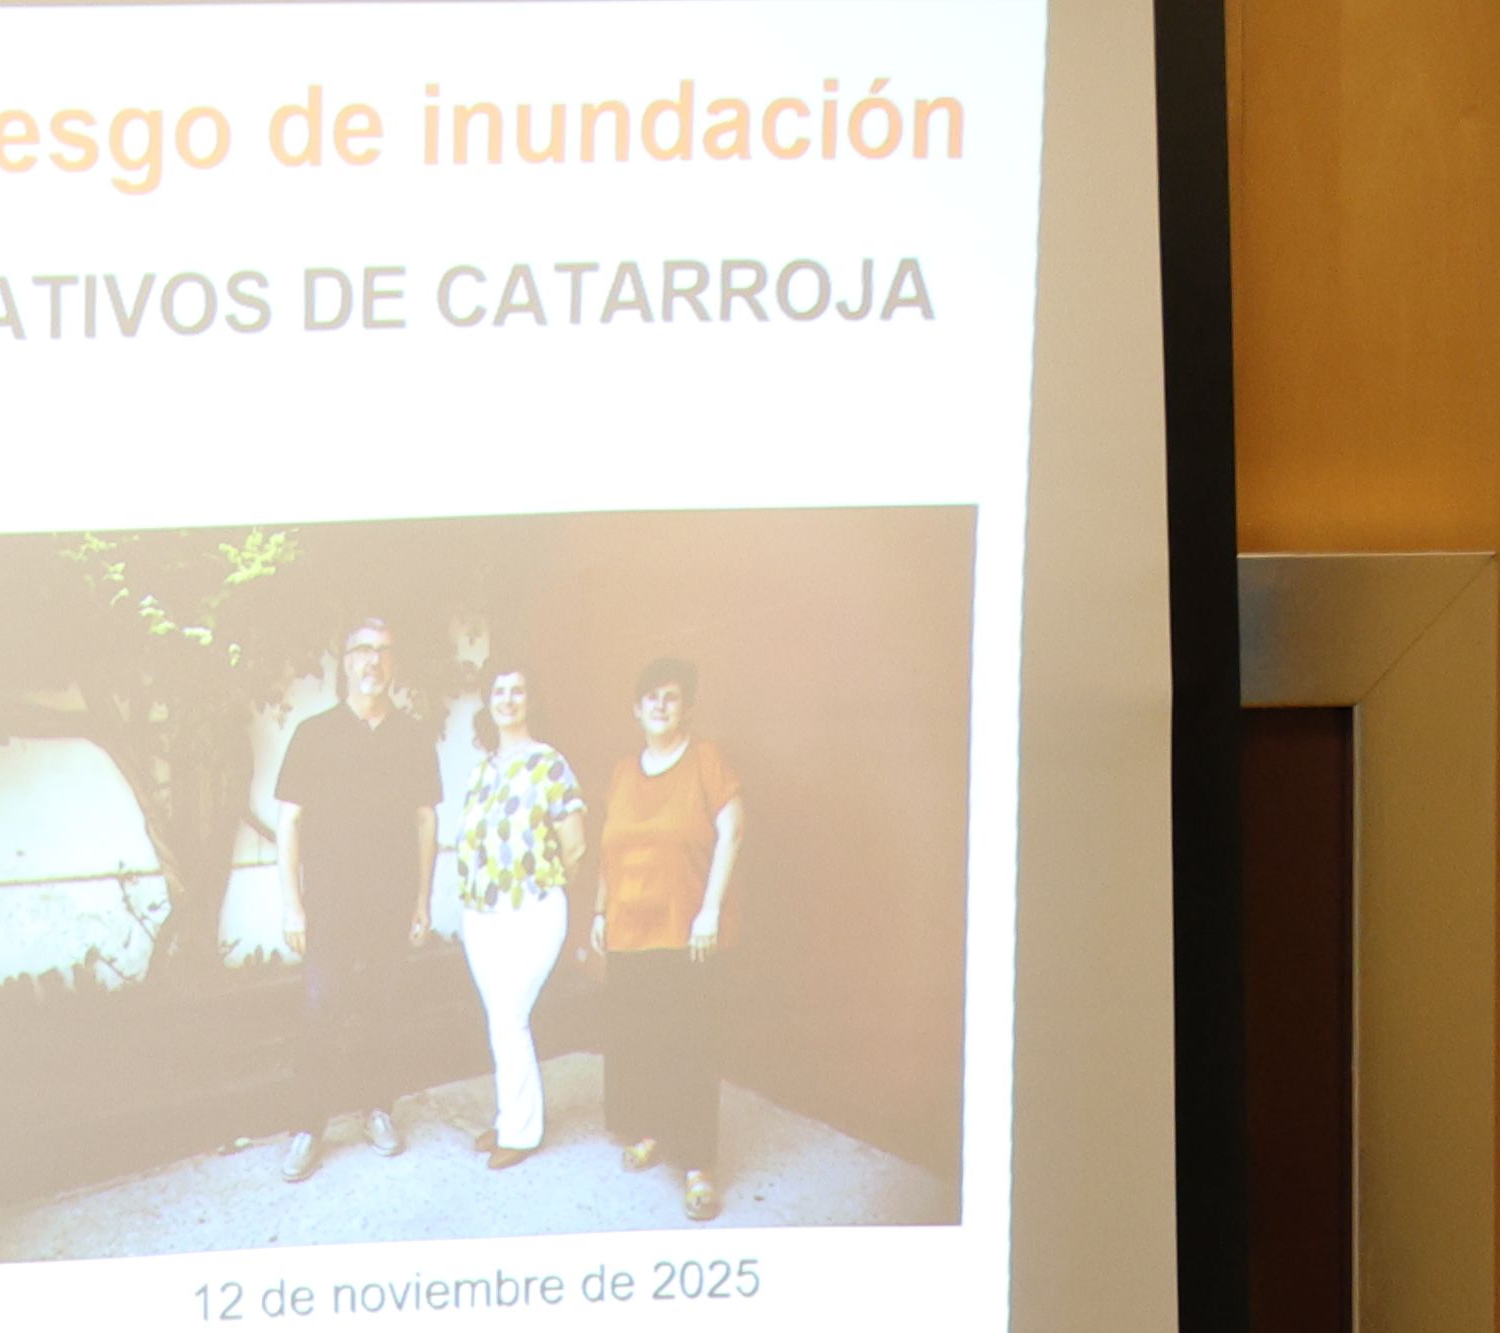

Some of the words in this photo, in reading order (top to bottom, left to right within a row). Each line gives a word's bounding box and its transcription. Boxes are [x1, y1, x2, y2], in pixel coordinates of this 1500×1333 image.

[268, 83, 384, 167] de
[423, 76, 964, 165] inundación
[304, 264, 407, 332] DE
[436, 256, 937, 328] CATARROJA
[194, 1280, 244, 1321] 12
[261, 1278, 315, 1318] de
[333, 1268, 565, 1314] noviembre
[581, 1264, 635, 1303] de
[652, 1257, 760, 1300] 2025
